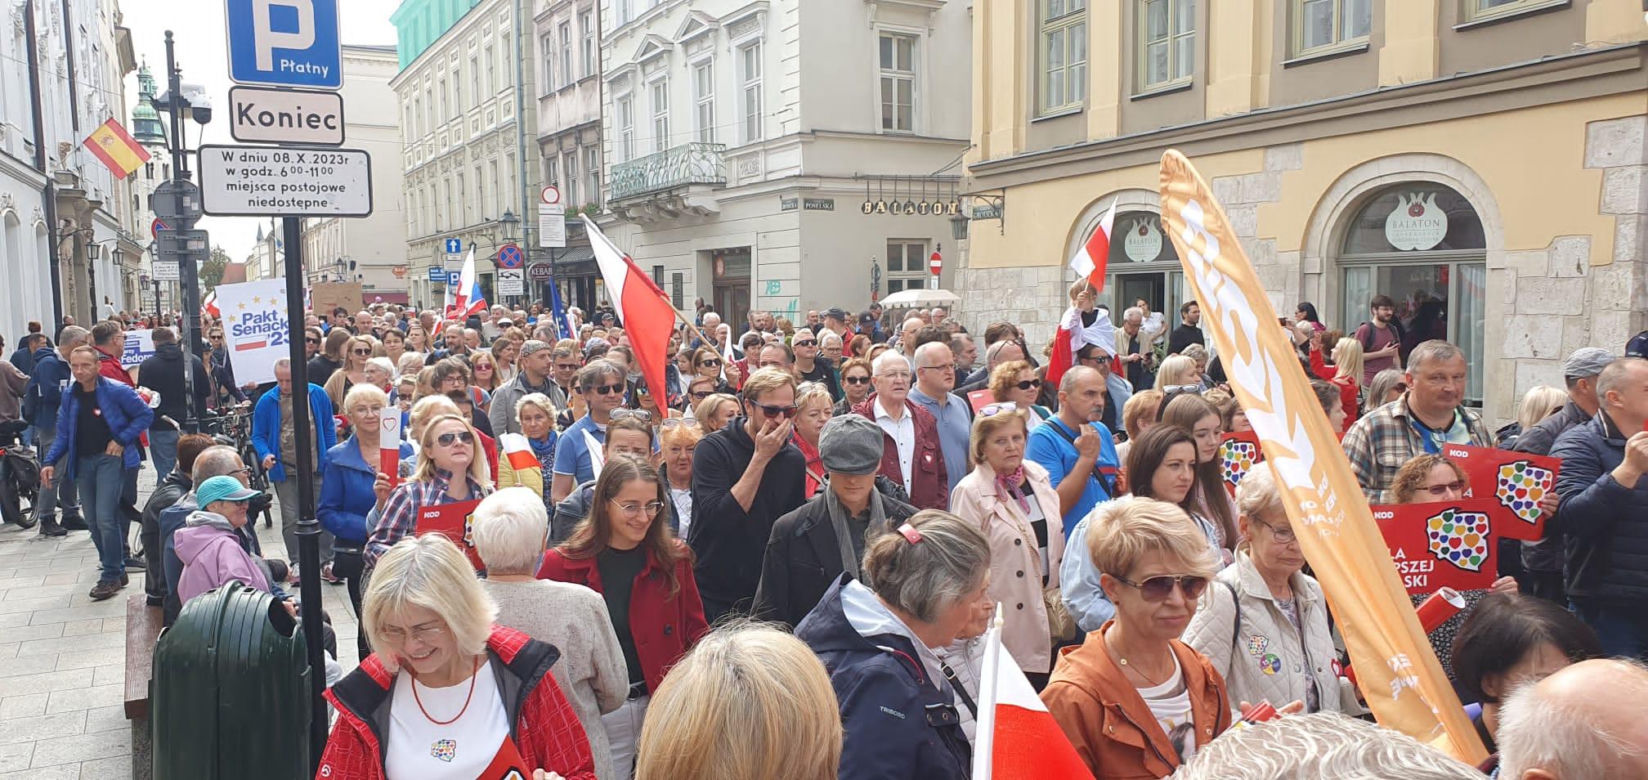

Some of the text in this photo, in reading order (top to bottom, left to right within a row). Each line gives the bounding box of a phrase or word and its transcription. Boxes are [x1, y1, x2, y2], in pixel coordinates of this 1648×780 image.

[252, 0, 315, 72] P
[280, 59, 328, 79] Płatny
[237, 102, 336, 130] Koniec
[222, 151, 234, 162] W
[240, 151, 268, 163] dniu
[226, 168, 236, 176] w
[241, 166, 277, 179] godz.
[226, 181, 345, 194] miejsca postojowe
[248, 197, 328, 210] niedostępne
[864, 200, 959, 215] BALATON
[1392, 219, 1440, 229] BALATON
[242, 309, 278, 325] Pakt
[232, 317, 289, 336] Senack
[1449, 449, 1468, 458] KOD
[1374, 511, 1394, 519] KOD
